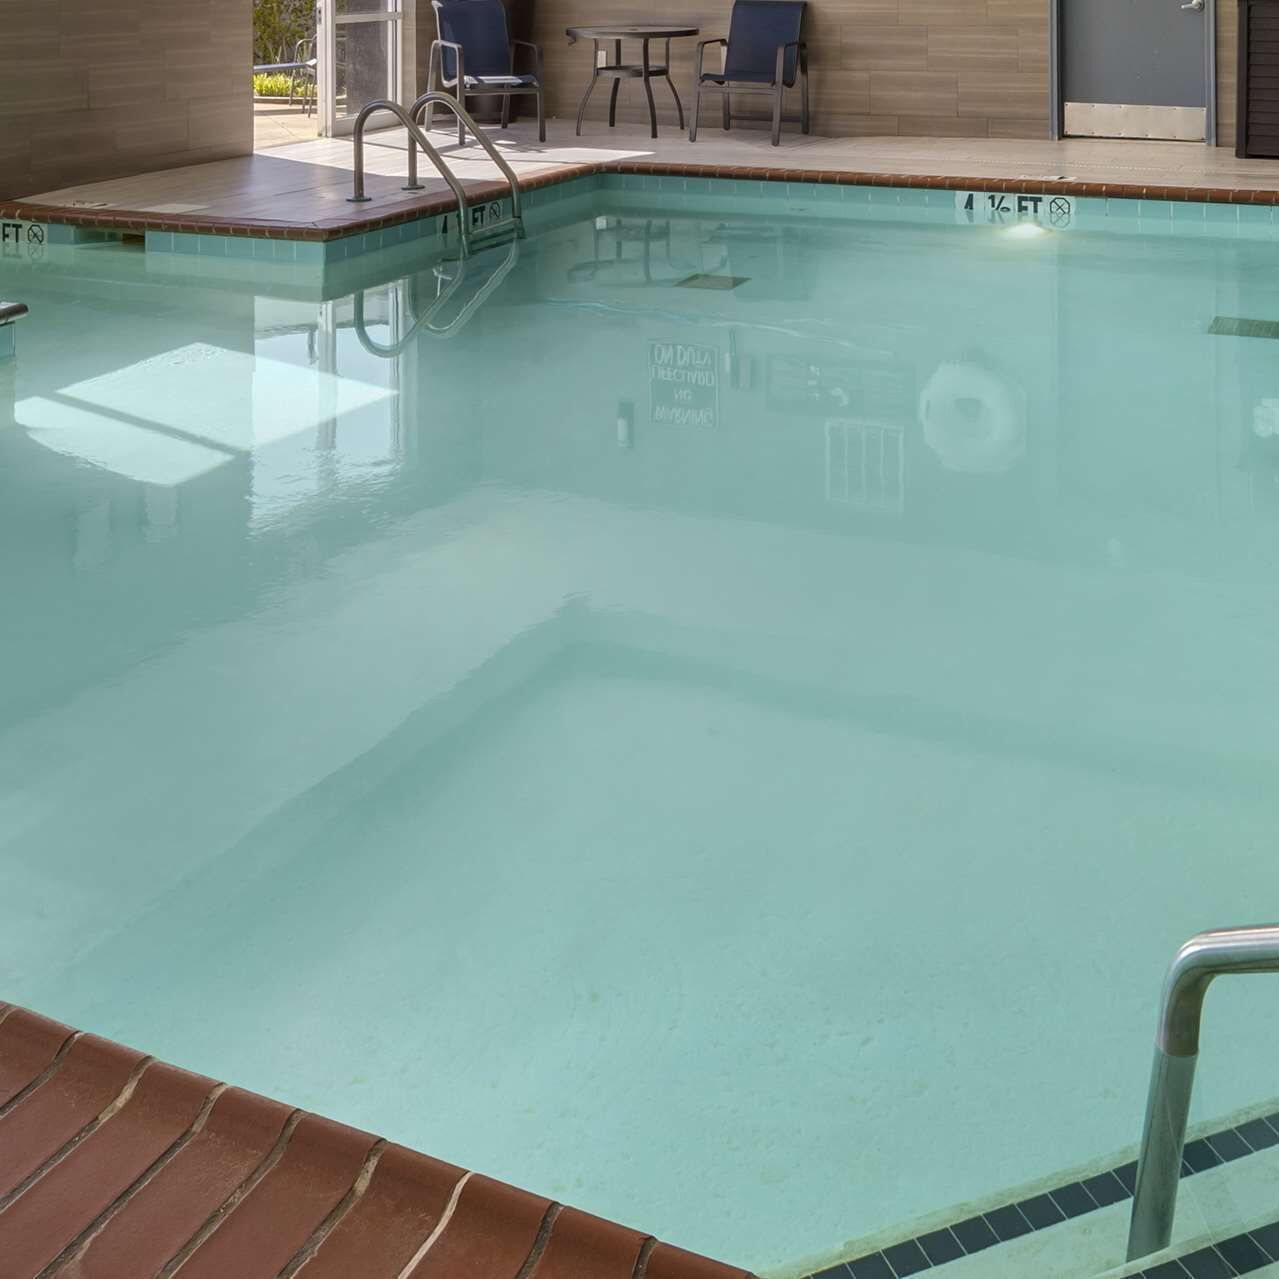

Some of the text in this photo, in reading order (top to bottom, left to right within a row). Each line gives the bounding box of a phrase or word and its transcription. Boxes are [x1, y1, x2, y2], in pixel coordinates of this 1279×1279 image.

[1017, 195, 1043, 213] FT
[472, 205, 486, 226] FT
[2, 223, 22, 243] FT
